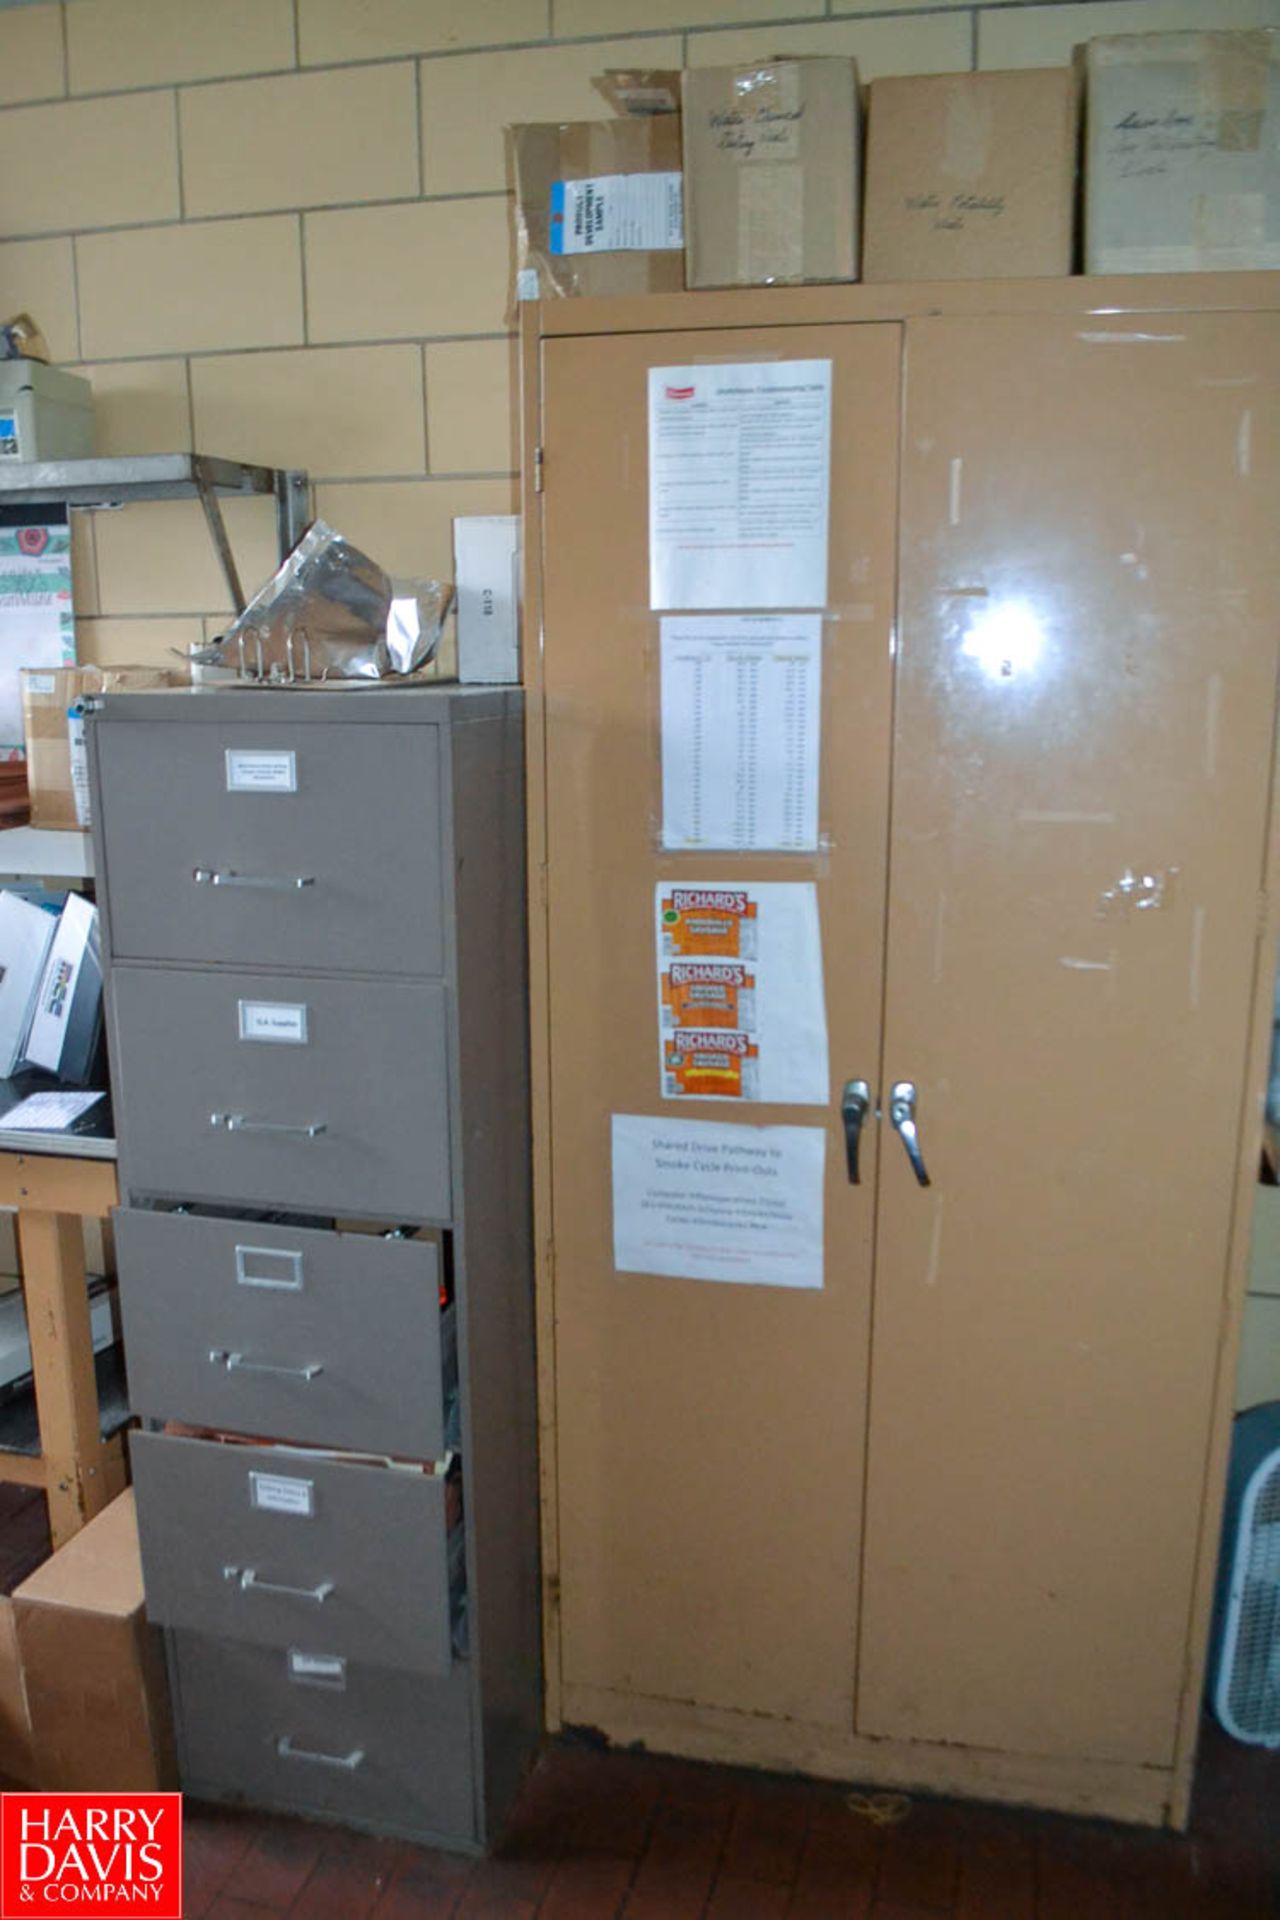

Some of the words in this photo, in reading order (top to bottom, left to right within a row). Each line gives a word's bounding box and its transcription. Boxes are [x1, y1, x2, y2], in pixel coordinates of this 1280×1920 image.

[574, 195, 583, 236] PRODUCT
[584, 183, 595, 247] DEVELOPMENT
[595, 195, 604, 232] SAMPLE
[673, 891, 746, 914] RICHARD'S
[671, 964, 744, 986] RICHARD'S
[675, 1033, 748, 1057] RICHARD'S
[652, 1139, 688, 1152] Shared
[691, 1141, 718, 1153] Drive
[721, 1143, 767, 1158] Pathway
[655, 1157, 690, 1171] Smoke
[693, 1159, 721, 1173] Cycle
